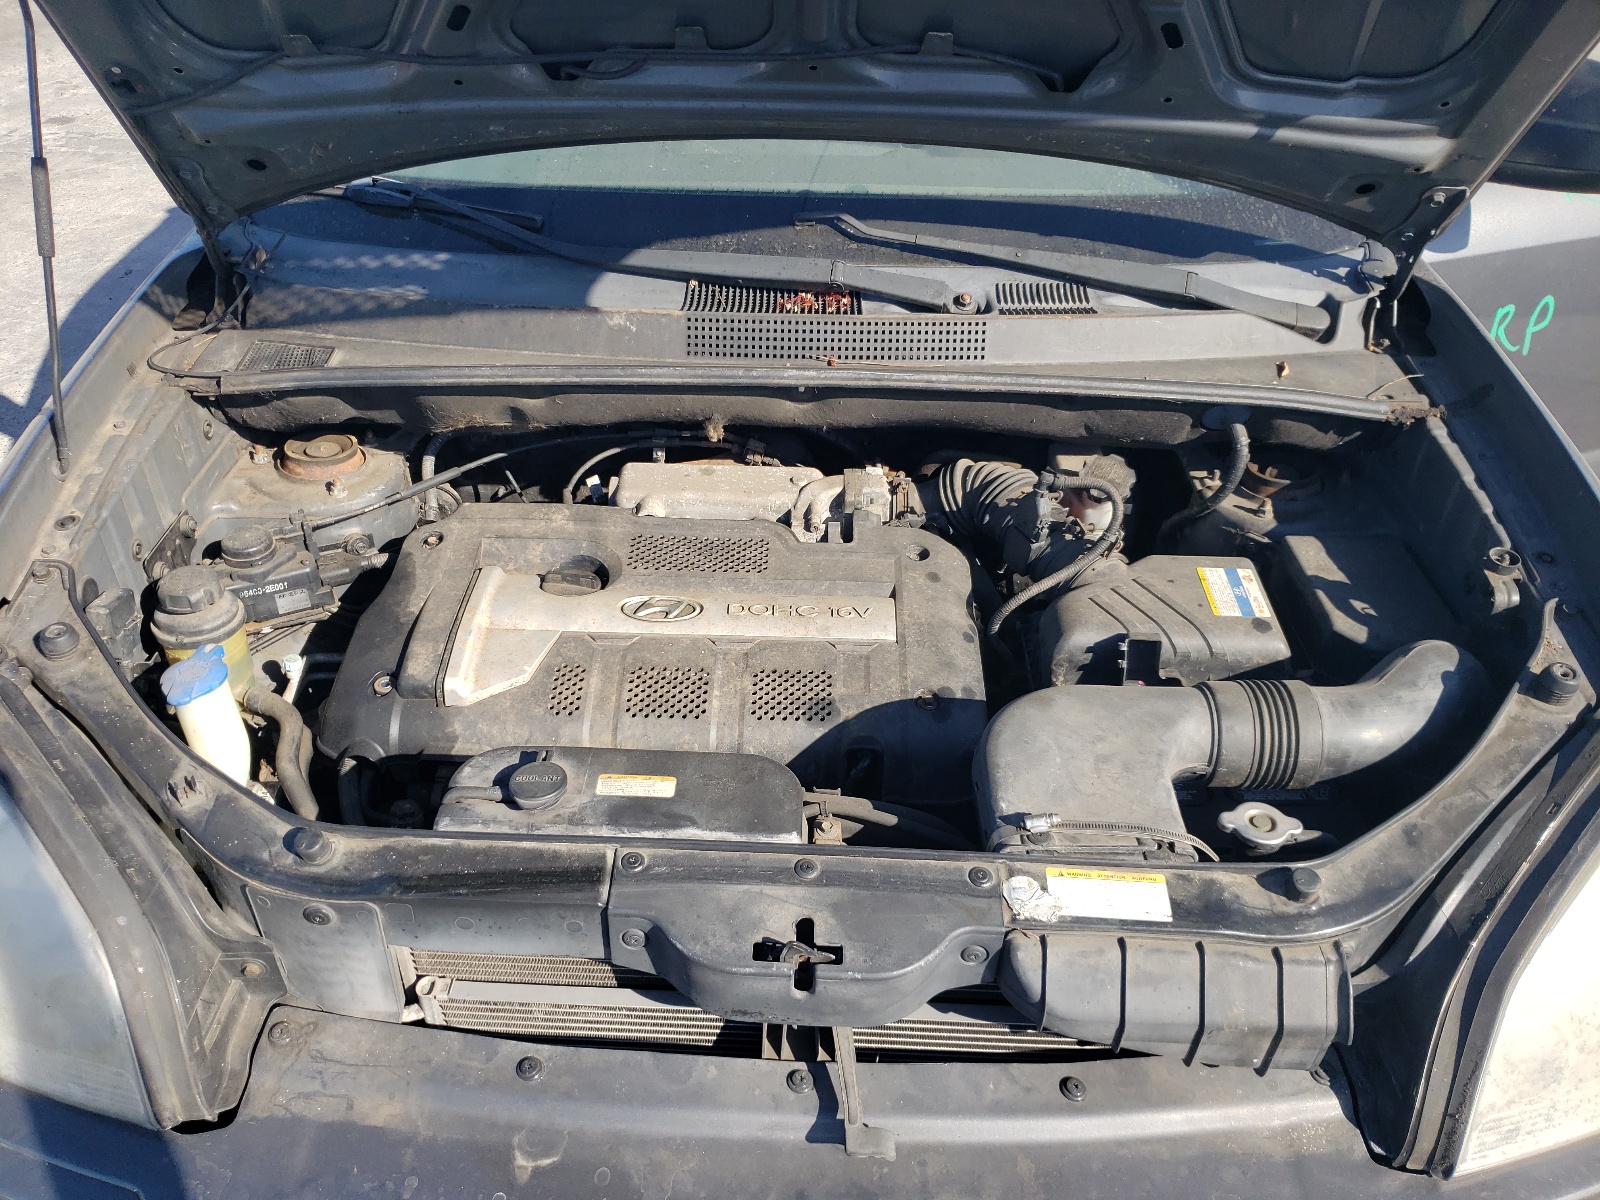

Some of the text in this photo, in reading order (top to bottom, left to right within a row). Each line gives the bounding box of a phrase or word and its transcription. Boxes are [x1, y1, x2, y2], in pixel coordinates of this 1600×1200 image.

[1490, 294, 1555, 356] RP
[726, 603, 873, 618] DOHC 16V
[514, 774, 562, 783] COOLANT
